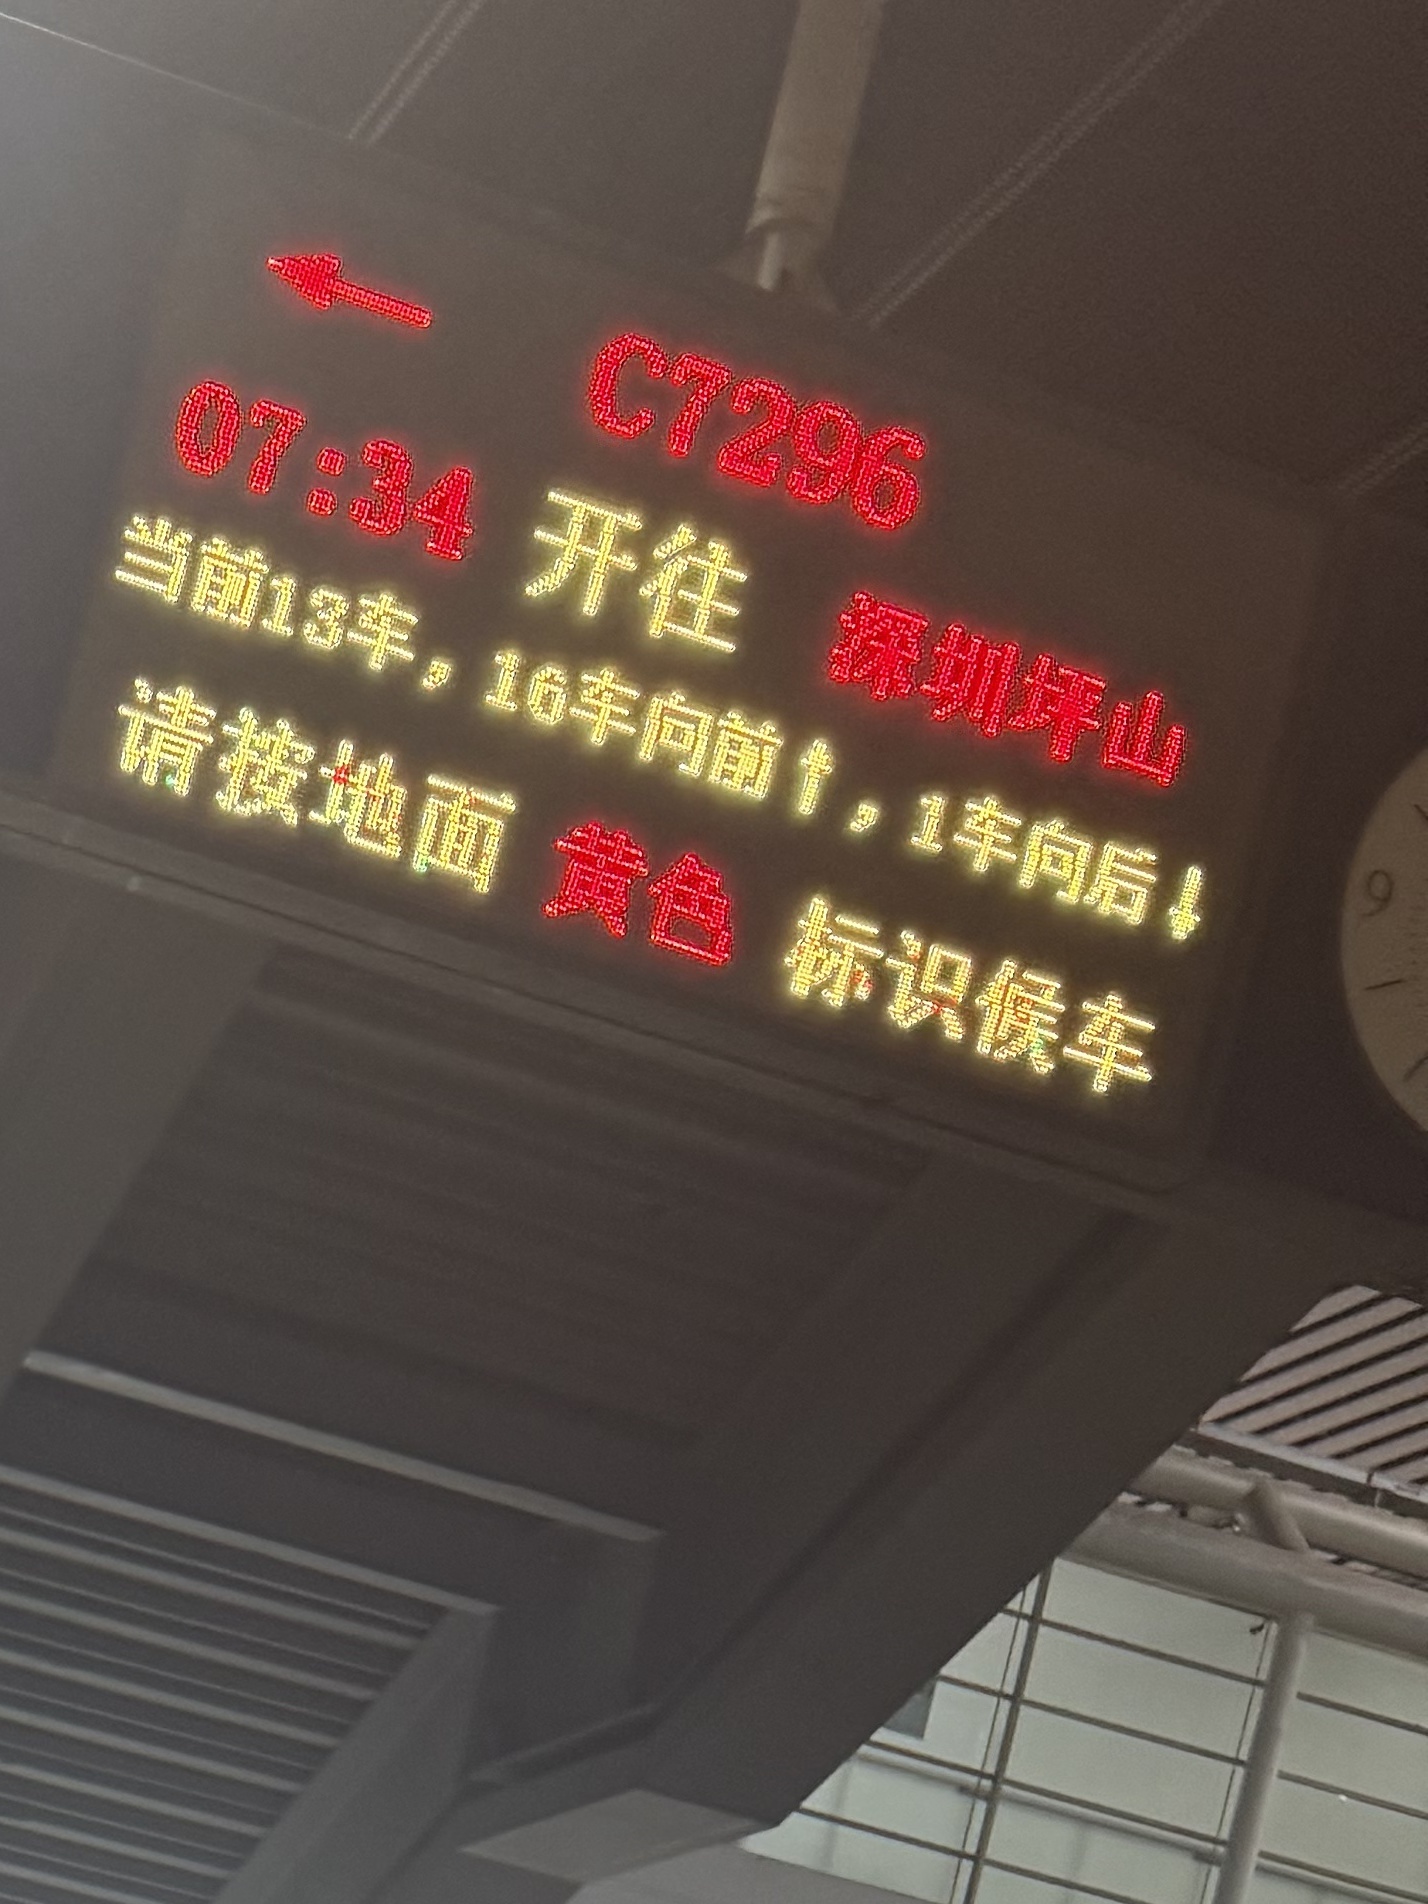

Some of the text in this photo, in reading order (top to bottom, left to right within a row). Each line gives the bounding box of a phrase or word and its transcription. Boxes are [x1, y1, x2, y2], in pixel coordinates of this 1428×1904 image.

[175, 380, 1186, 788] 07:34 开往 深圳坪山
[587, 332, 927, 534] C7296
[117, 677, 1156, 1094] 请按地面 黄色 标识候车
